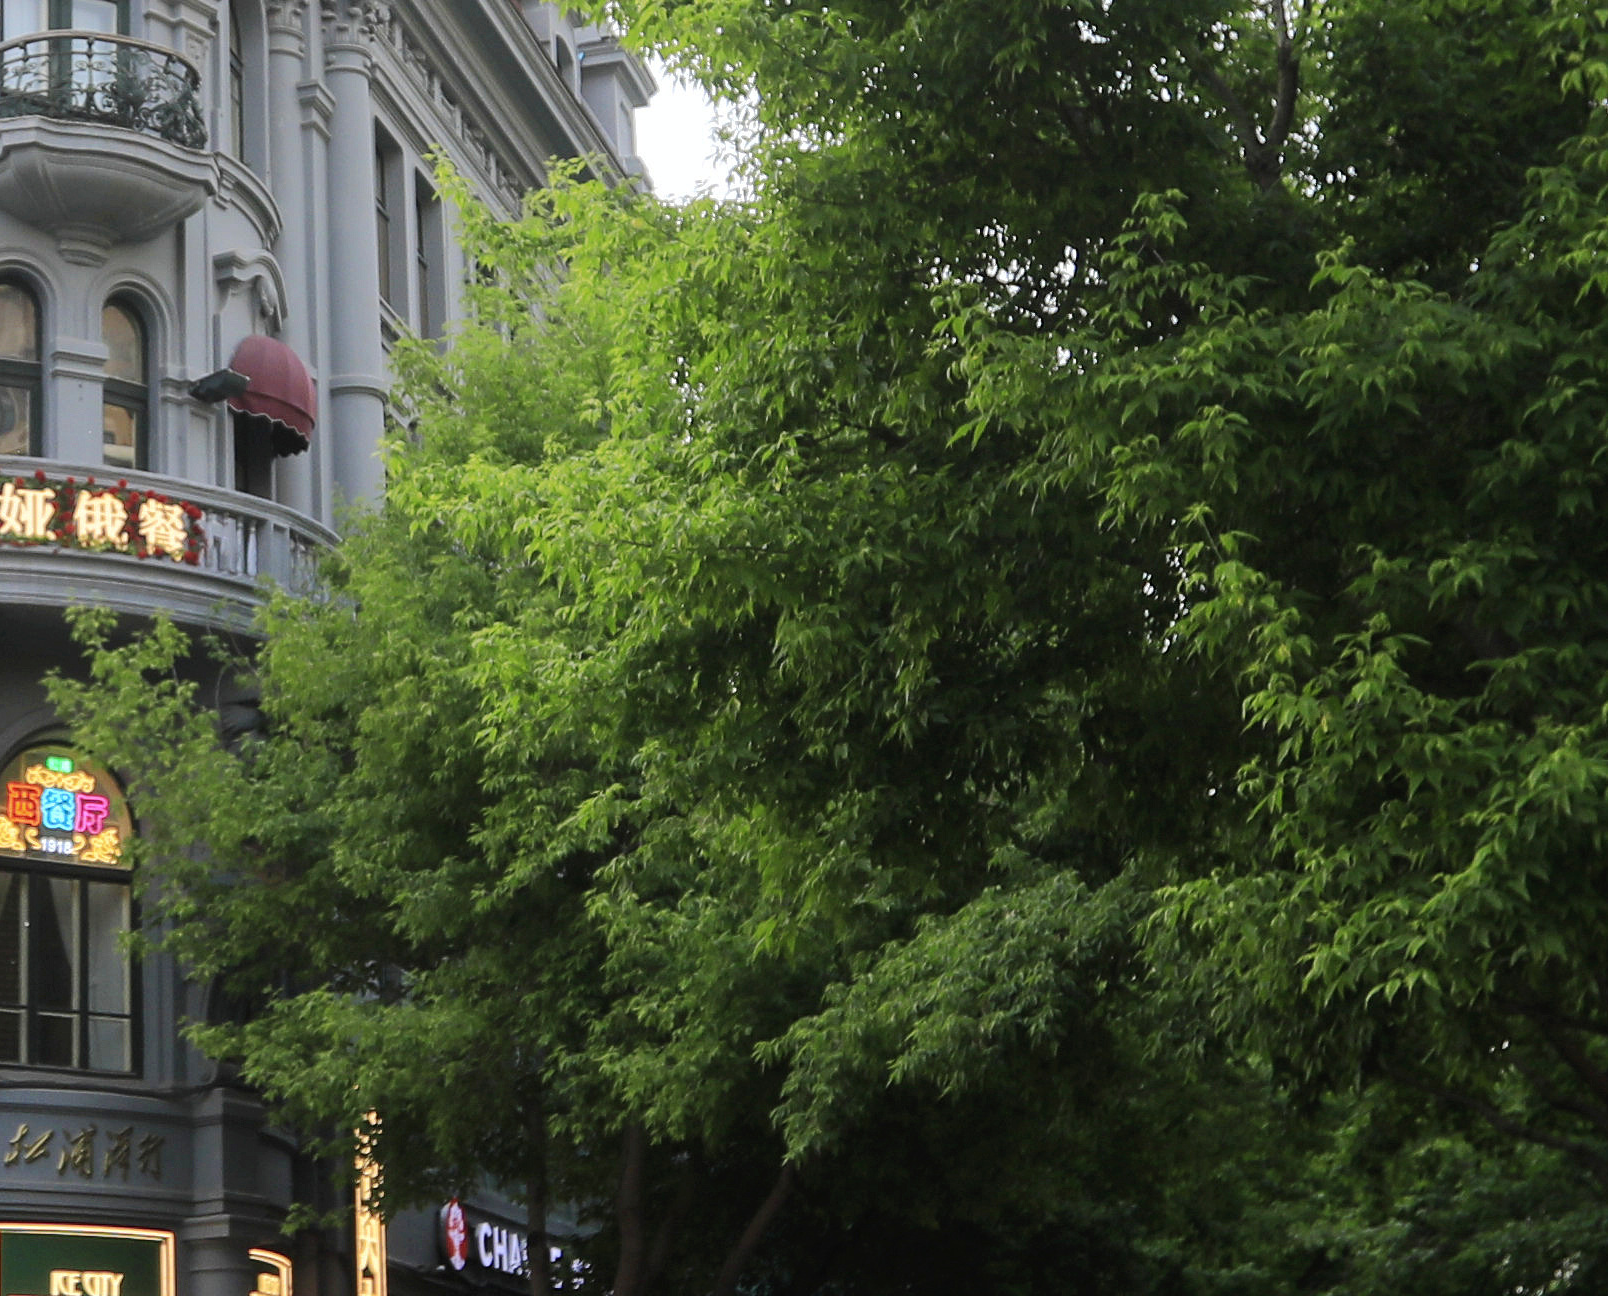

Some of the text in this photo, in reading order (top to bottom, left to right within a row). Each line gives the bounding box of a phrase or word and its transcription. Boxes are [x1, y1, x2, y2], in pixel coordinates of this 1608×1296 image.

[6, 782, 110, 835] 西餐厅
[40, 837, 74, 854] 1918
[50, 1269, 82, 1296] ICE
